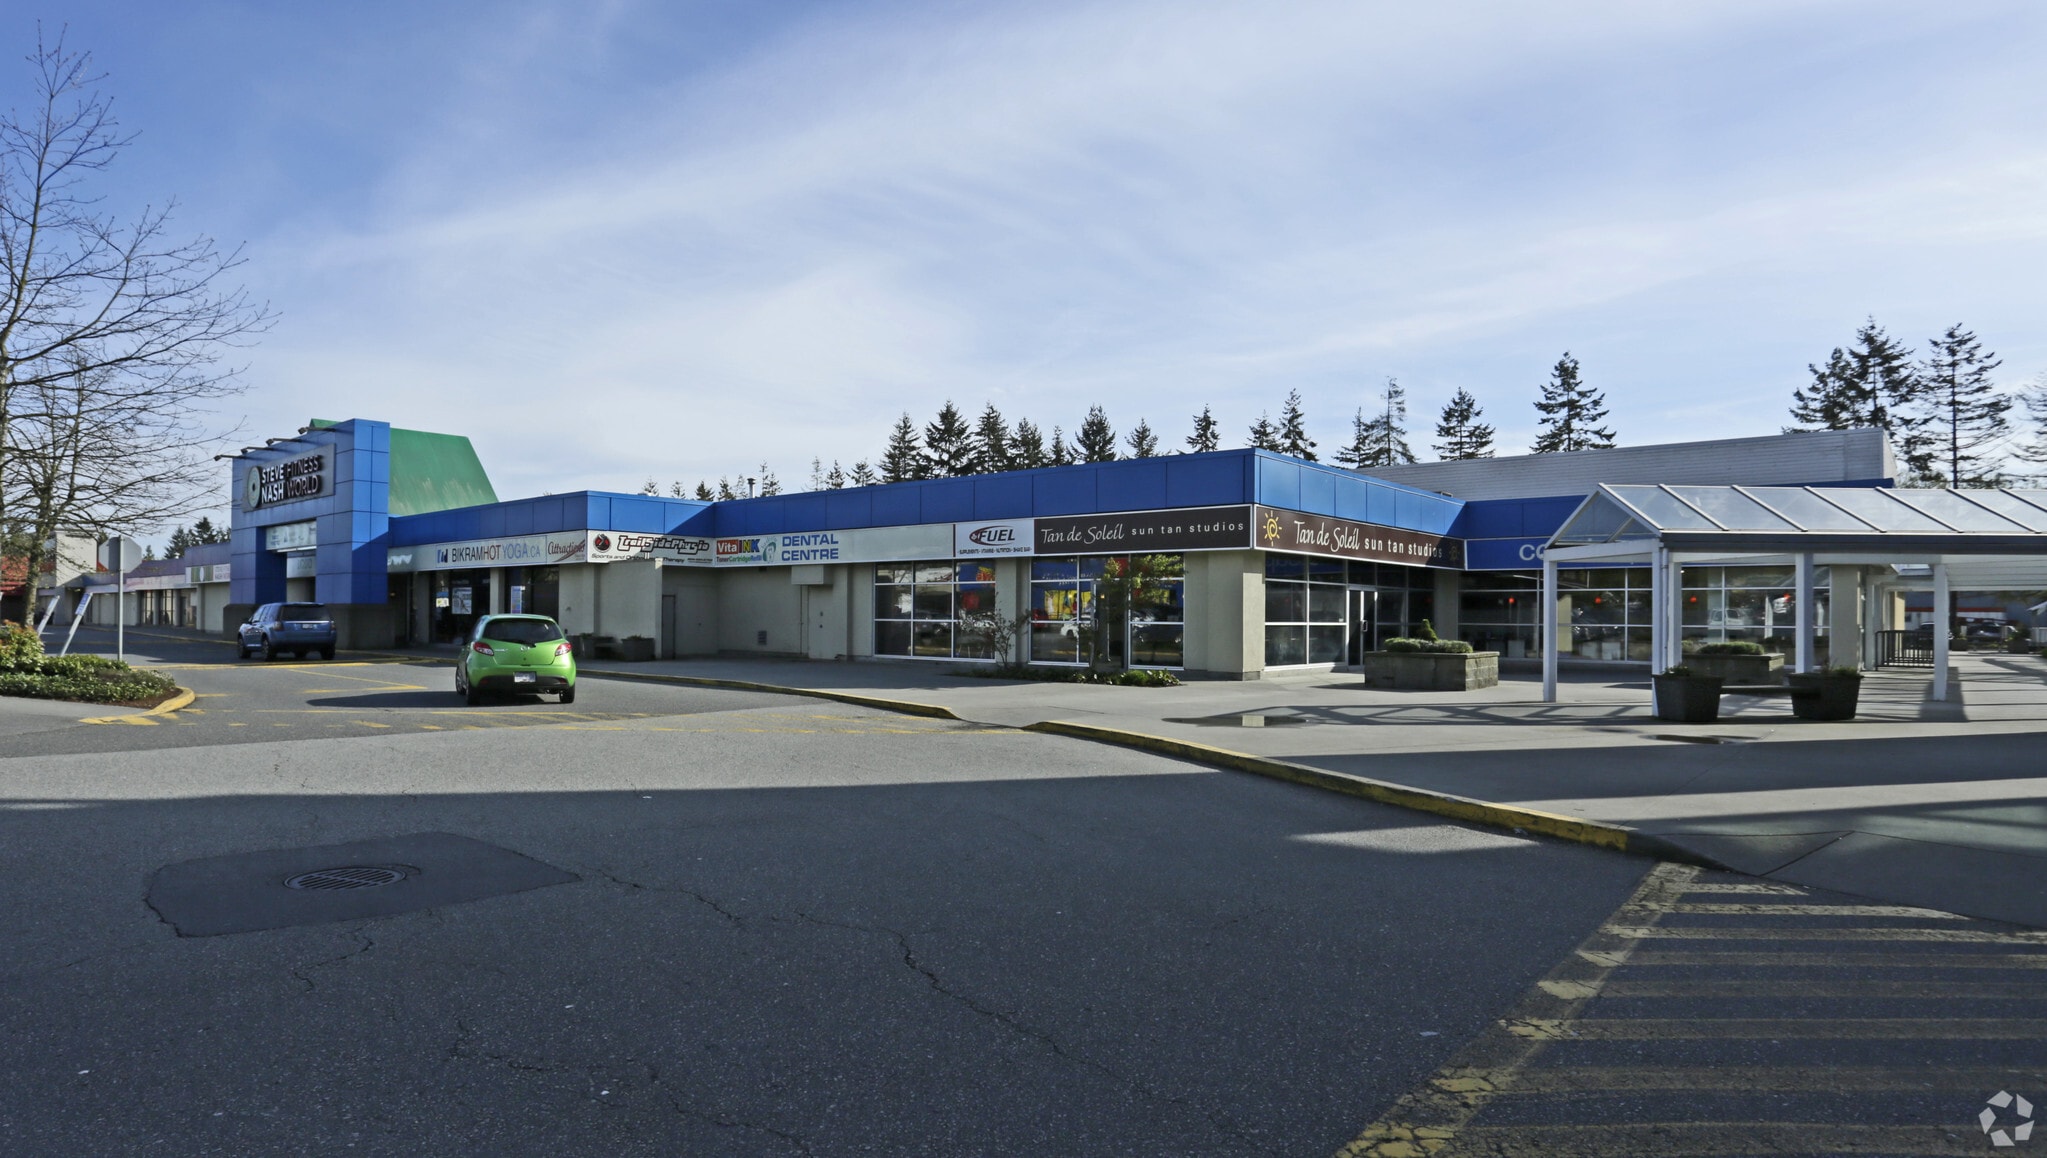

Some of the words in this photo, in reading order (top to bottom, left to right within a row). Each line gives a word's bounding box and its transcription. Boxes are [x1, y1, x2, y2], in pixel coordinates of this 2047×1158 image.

[261, 463, 285, 484] STEVE
[286, 455, 321, 477] FITNESS
[261, 480, 285, 504] NASH
[286, 474, 320, 498] WORLD
[782, 533, 839, 547] DENTAL
[979, 528, 1016, 542] FUEL
[1040, 528, 1064, 544] Tan
[1066, 525, 1082, 542] de
[1131, 527, 1154, 536] sun
[1160, 525, 1182, 535] tan
[1189, 521, 1244, 533] studios
[1293, 520, 1316, 545] Tan
[1316, 521, 1331, 546] de
[1364, 537, 1383, 552] sun
[1387, 539, 1404, 554] tan
[1407, 542, 1443, 559] studios
[717, 542, 738, 553] Vita
[781, 548, 839, 561] CENTRE
